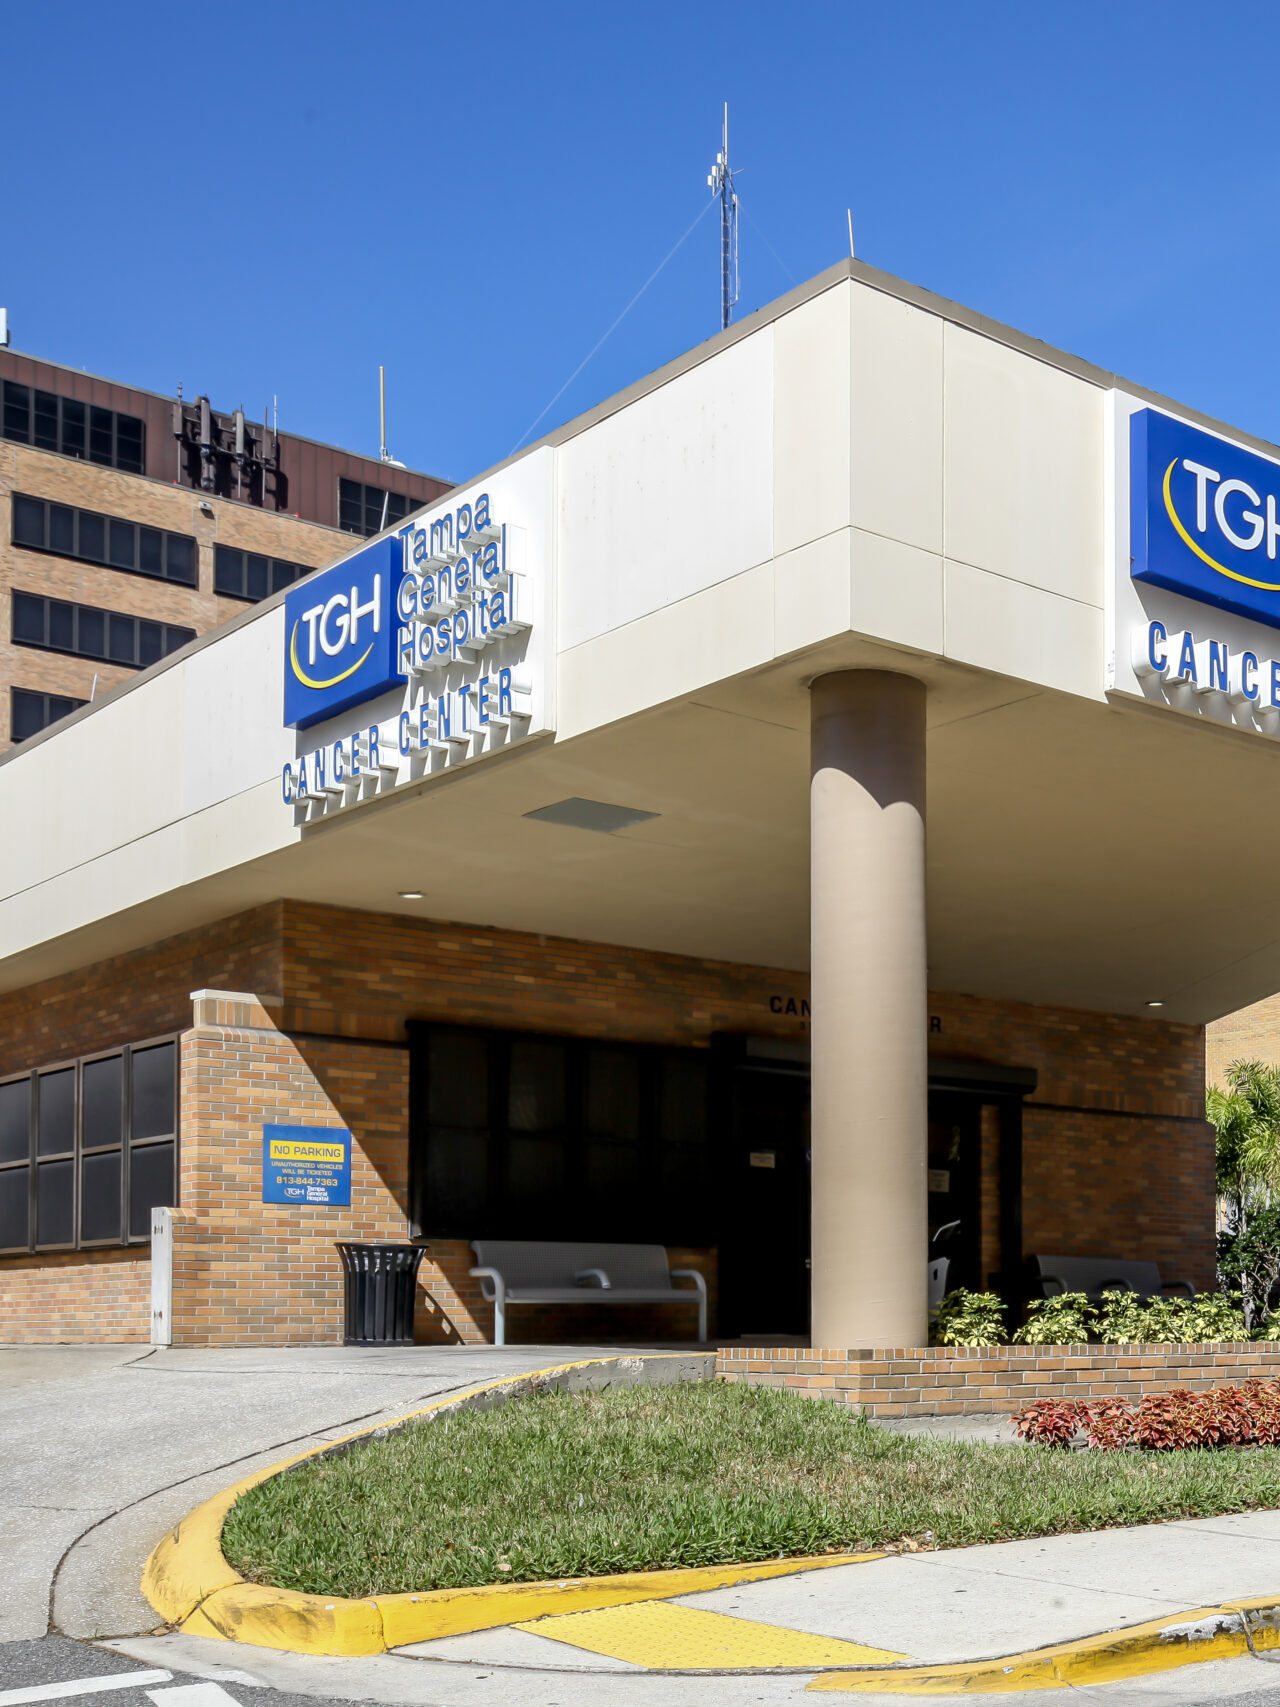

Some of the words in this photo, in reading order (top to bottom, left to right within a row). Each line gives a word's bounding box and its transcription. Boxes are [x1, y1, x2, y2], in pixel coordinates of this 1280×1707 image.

[397, 523, 507, 622] General
[399, 493, 491, 573] Tampa
[302, 573, 381, 665] TGH
[398, 573, 513, 675] Hospital
[282, 724, 379, 805] CANCER
[399, 667, 512, 755] CENTER
[770, 996, 811, 1016] CAN
[274, 1145, 290, 1154] NO
[294, 1146, 341, 1157] PARKING
[276, 1176, 338, 1187] 813-844-7363
